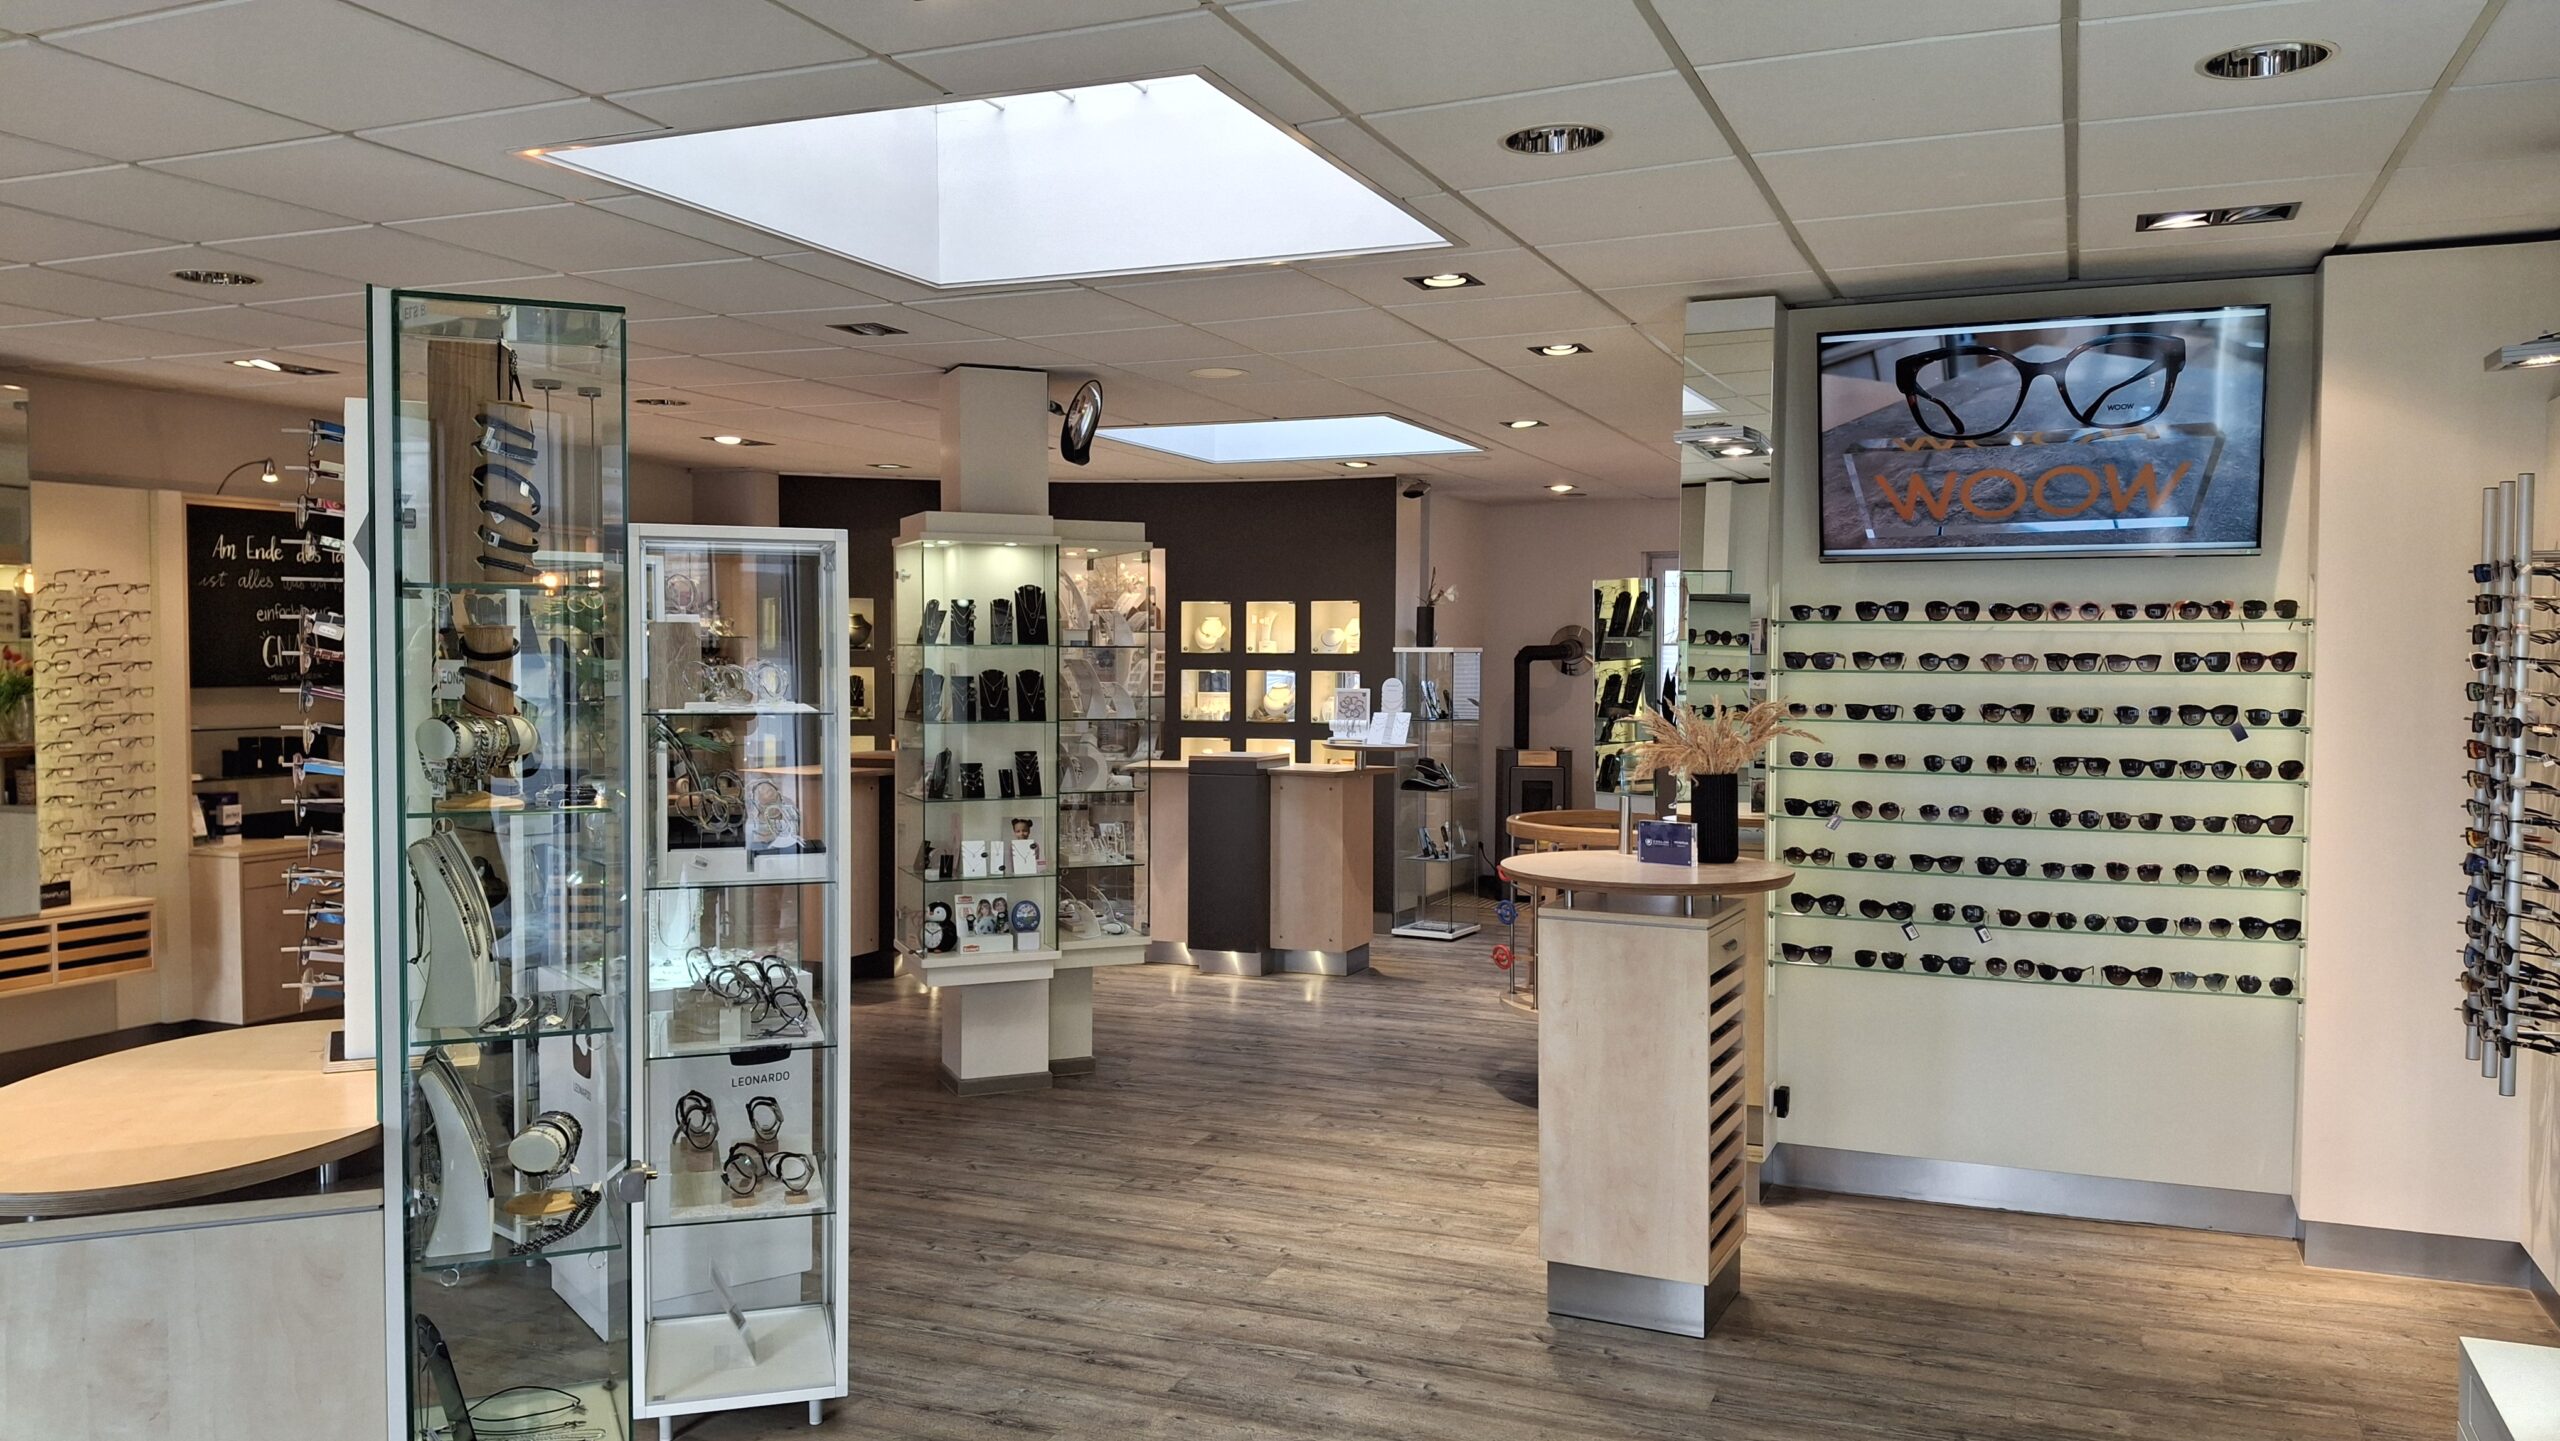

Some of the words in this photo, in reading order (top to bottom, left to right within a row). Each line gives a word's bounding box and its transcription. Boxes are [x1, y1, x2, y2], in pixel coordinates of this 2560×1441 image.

[2107, 403, 2135, 411] WOOW
[1874, 460, 2192, 521] WOOW
[212, 534, 237, 560] Am
[246, 535, 284, 562] Ende
[199, 570, 228, 588] ist
[238, 569, 274, 589] alles
[731, 1071, 790, 1088] LEONARDO
